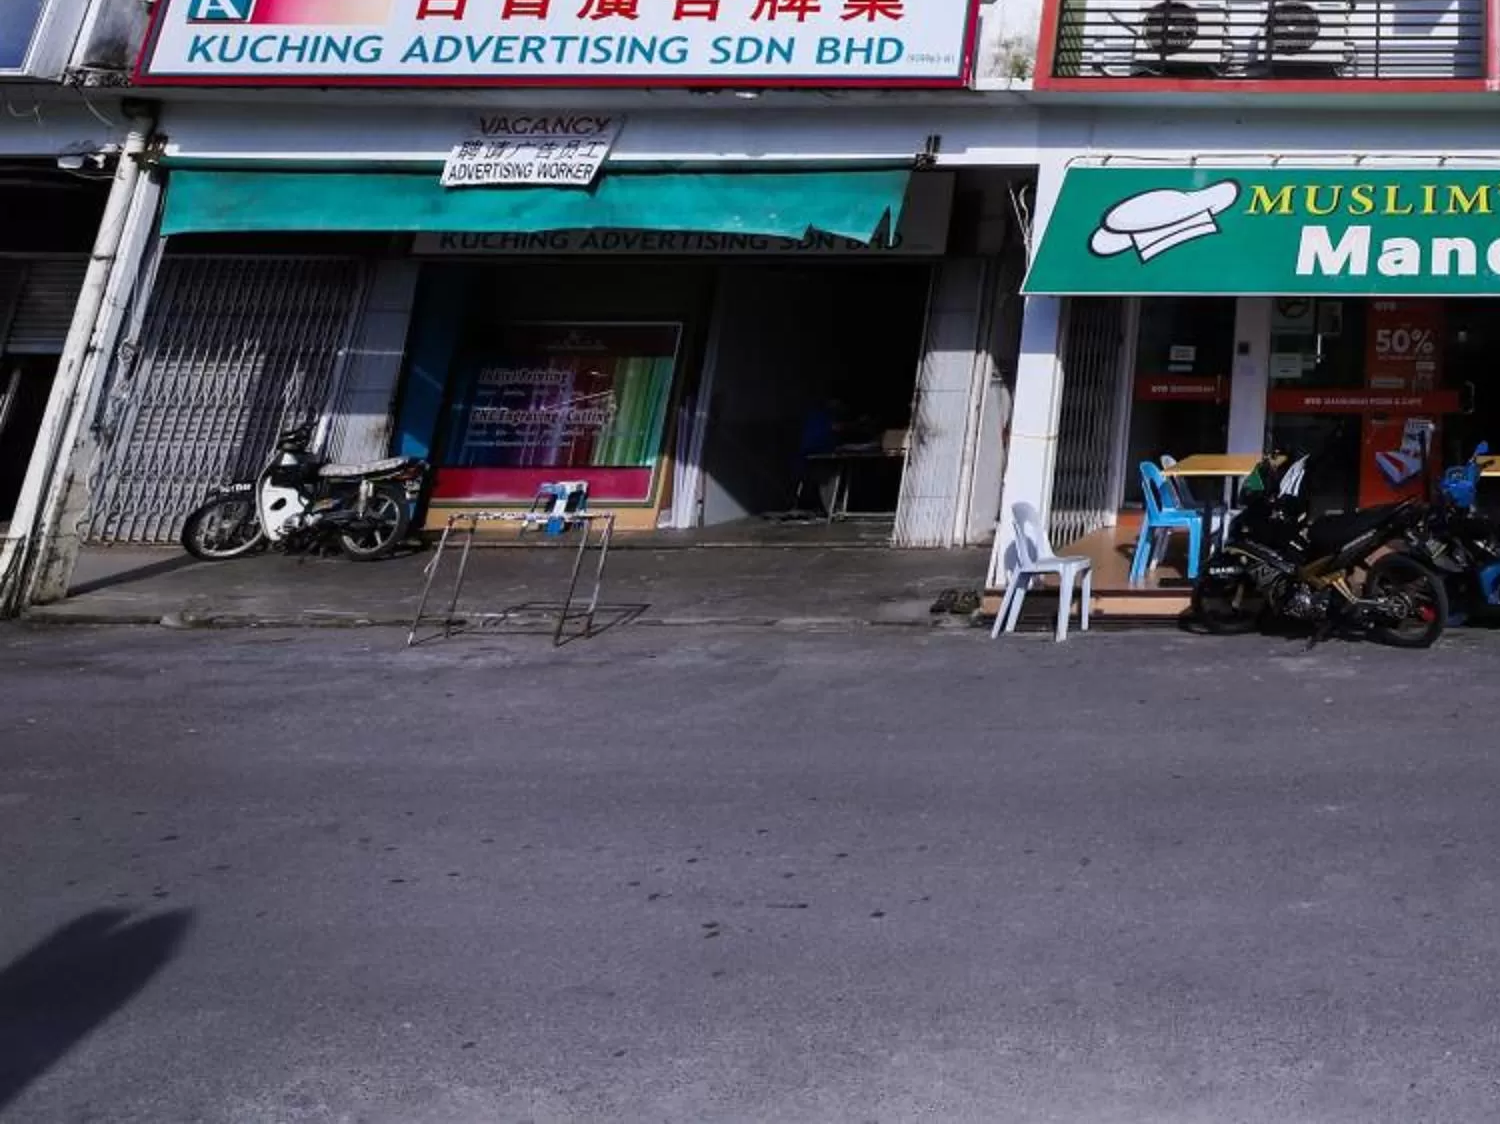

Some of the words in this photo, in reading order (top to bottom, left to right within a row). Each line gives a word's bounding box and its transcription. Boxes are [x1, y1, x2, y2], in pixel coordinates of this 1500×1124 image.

[186, 35, 384, 64] KUCHING
[400, 35, 691, 65] ADVERTISING
[709, 36, 797, 65] SDN
[815, 37, 905, 66] BHD
[479, 116, 612, 135] VACANCY
[448, 162, 533, 181] ADVERTISING
[537, 162, 594, 180] WORKER
[439, 232, 568, 250] KUCHING
[579, 230, 768, 250] ADVERTISING
[1376, 328, 1435, 354] 50%
